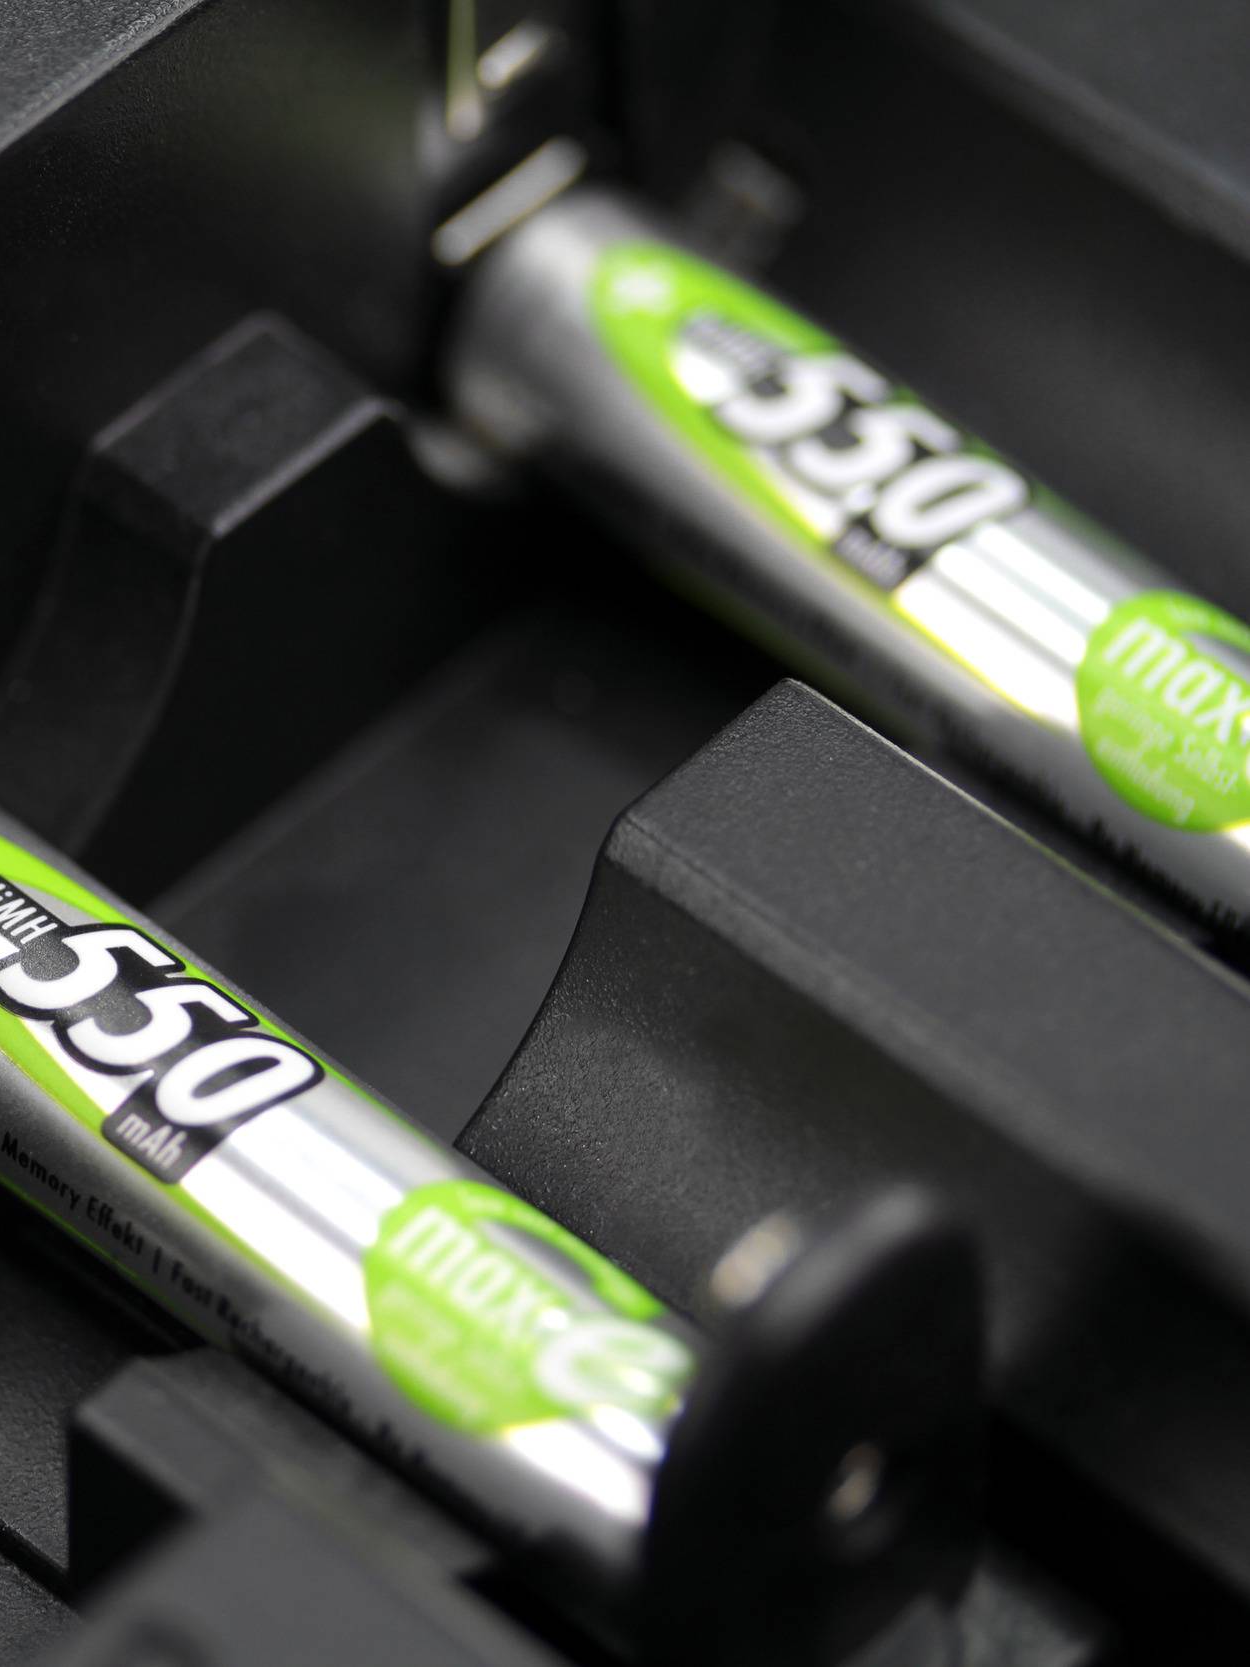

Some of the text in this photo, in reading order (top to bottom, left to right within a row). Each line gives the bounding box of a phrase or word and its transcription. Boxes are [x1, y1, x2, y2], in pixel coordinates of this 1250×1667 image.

[715, 352, 1027, 548] 550
[1, 1131, 81, 1211] Memory
[85, 1195, 144, 1255] Effekt
[115, 1112, 189, 1171] mAh
